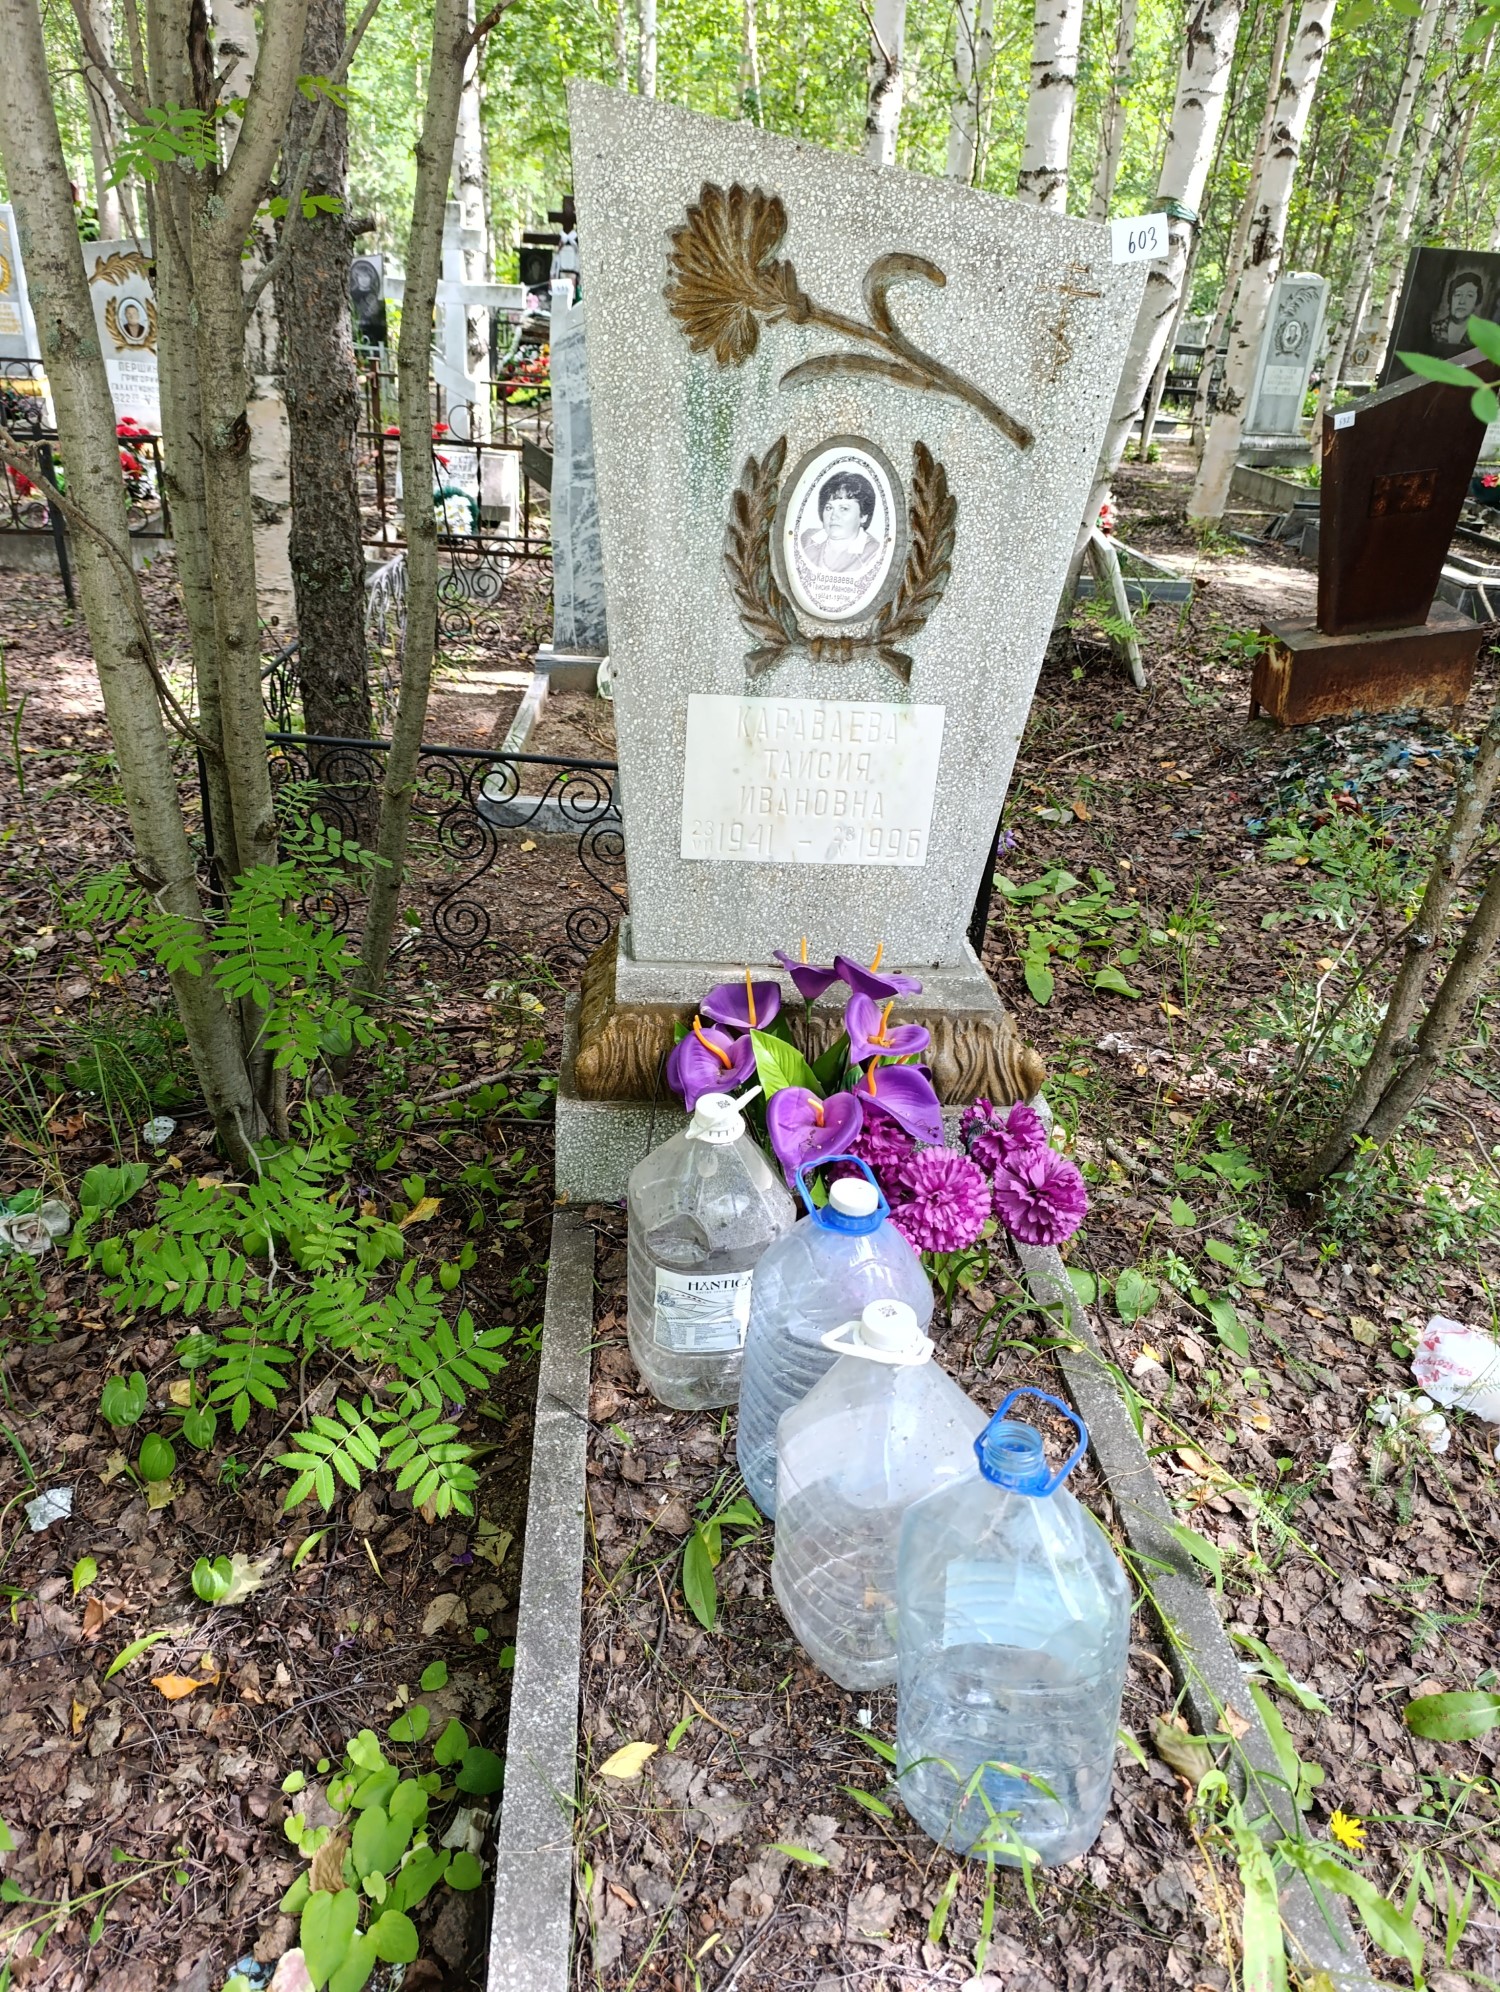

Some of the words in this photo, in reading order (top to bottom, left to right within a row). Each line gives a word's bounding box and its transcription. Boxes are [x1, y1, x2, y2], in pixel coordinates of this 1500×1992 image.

[1128, 226, 1158, 254] 603
[816, 573, 854, 585] Караваева
[737, 705, 899, 745] КАРАВАЕВА
[764, 749, 872, 782] ТАИСИЯ
[740, 785, 885, 819] ИВАНОВНА
[719, 821, 774, 855] 1941
[858, 826, 922, 858] 1996
